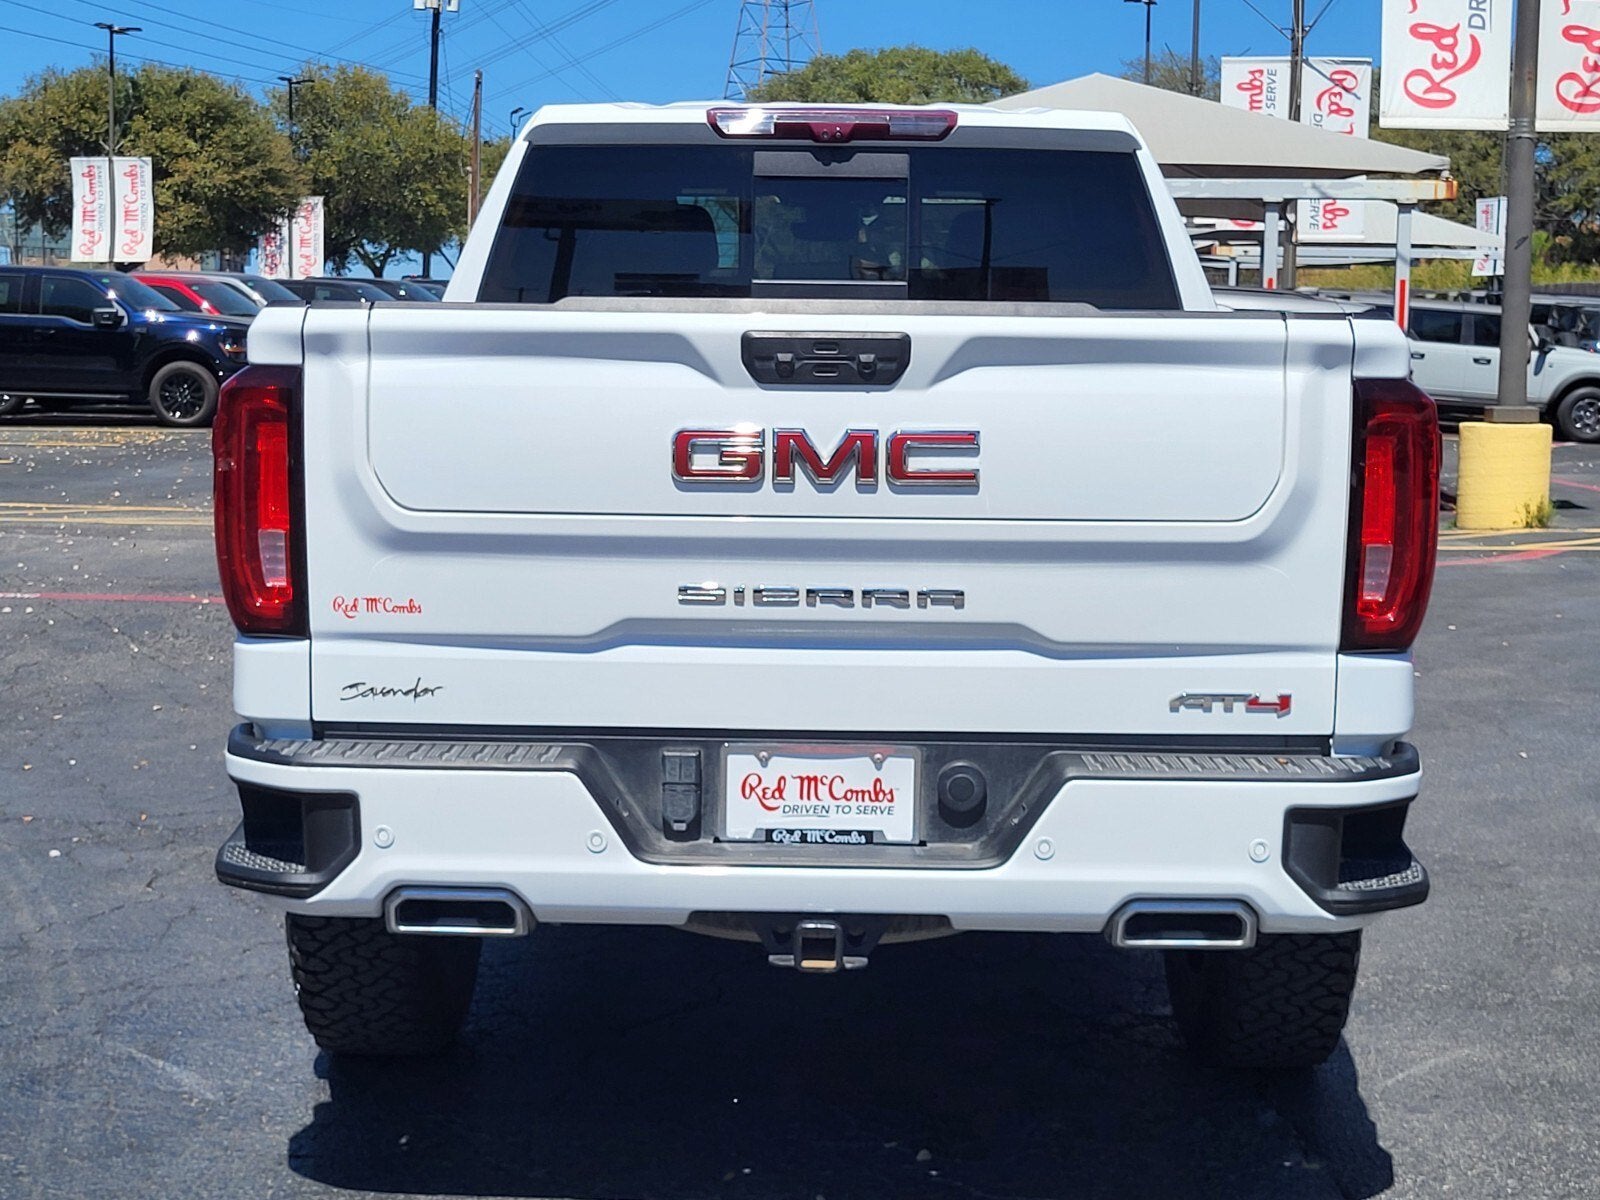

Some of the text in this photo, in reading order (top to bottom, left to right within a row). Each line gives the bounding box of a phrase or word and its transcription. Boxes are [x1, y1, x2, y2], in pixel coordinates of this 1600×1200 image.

[1403, 22, 1481, 109] Red
[1266, 68, 1277, 110] SERVE
[1316, 69, 1358, 118] Red
[79, 165, 101, 256] Red McCombs
[121, 164, 144, 256] Red McCombs
[671, 427, 981, 488] GMC
[333, 596, 422, 618] Red McCombs
[678, 582, 965, 608] SIERRA
[1169, 692, 1292, 718] AT4
[741, 773, 895, 811] Red McCombs
[782, 804, 895, 816] DRIVEN TO SERVE
[772, 829, 867, 844] Red McCombs
